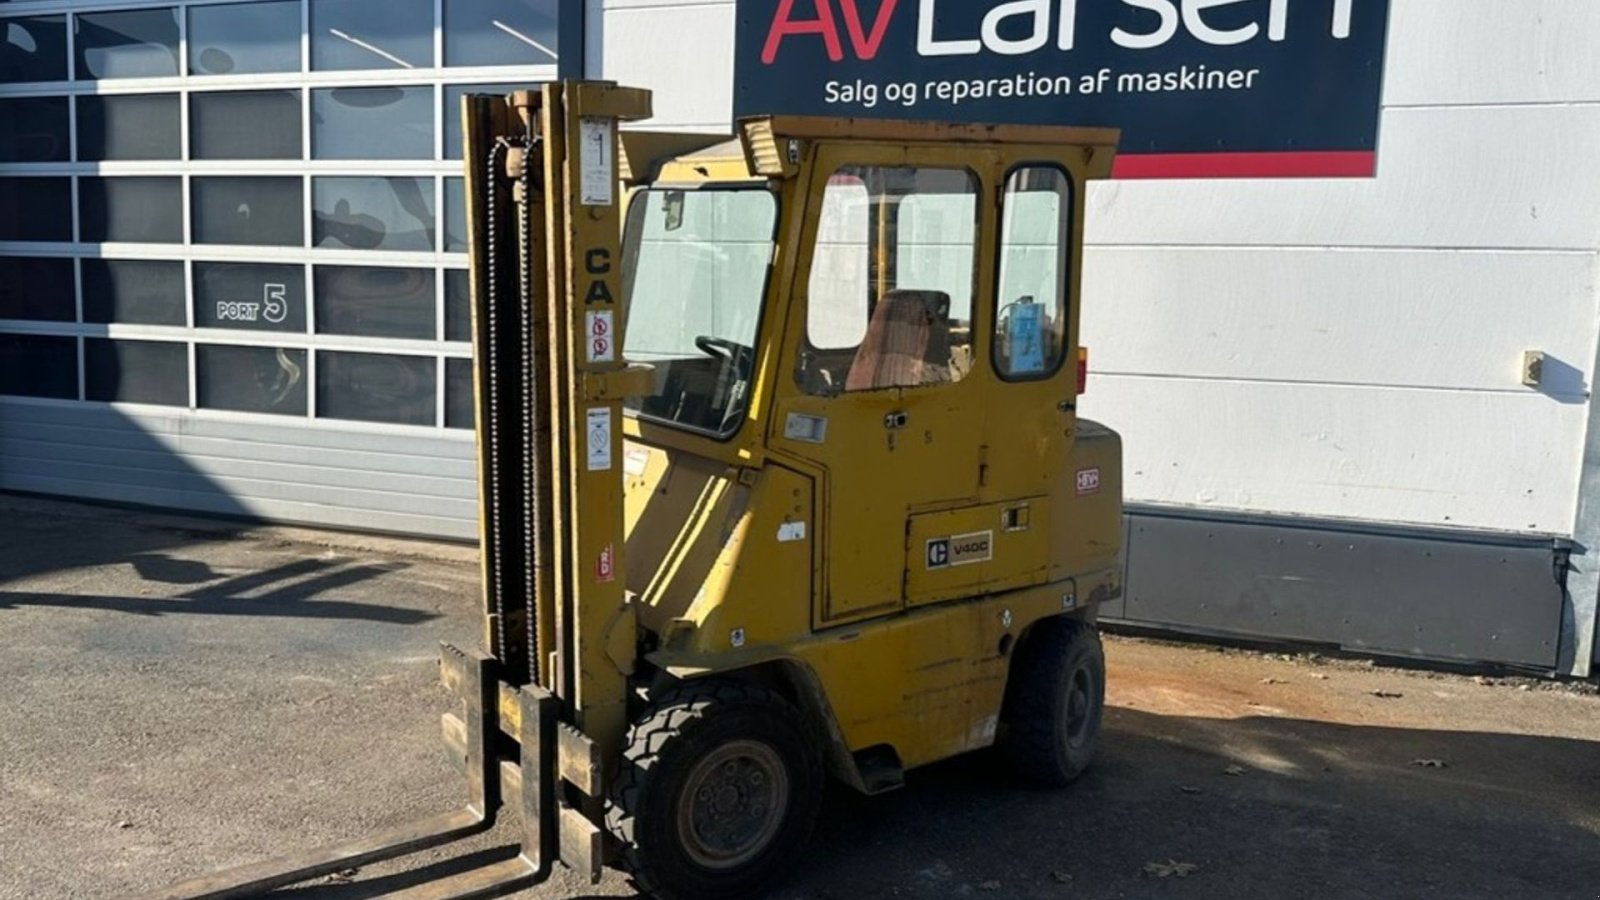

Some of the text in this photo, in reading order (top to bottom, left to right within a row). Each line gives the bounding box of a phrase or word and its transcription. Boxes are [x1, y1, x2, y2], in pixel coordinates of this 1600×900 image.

[824, 64, 1259, 108] Salg og reparation af maskiner
[216, 283, 288, 323] PORT 5
